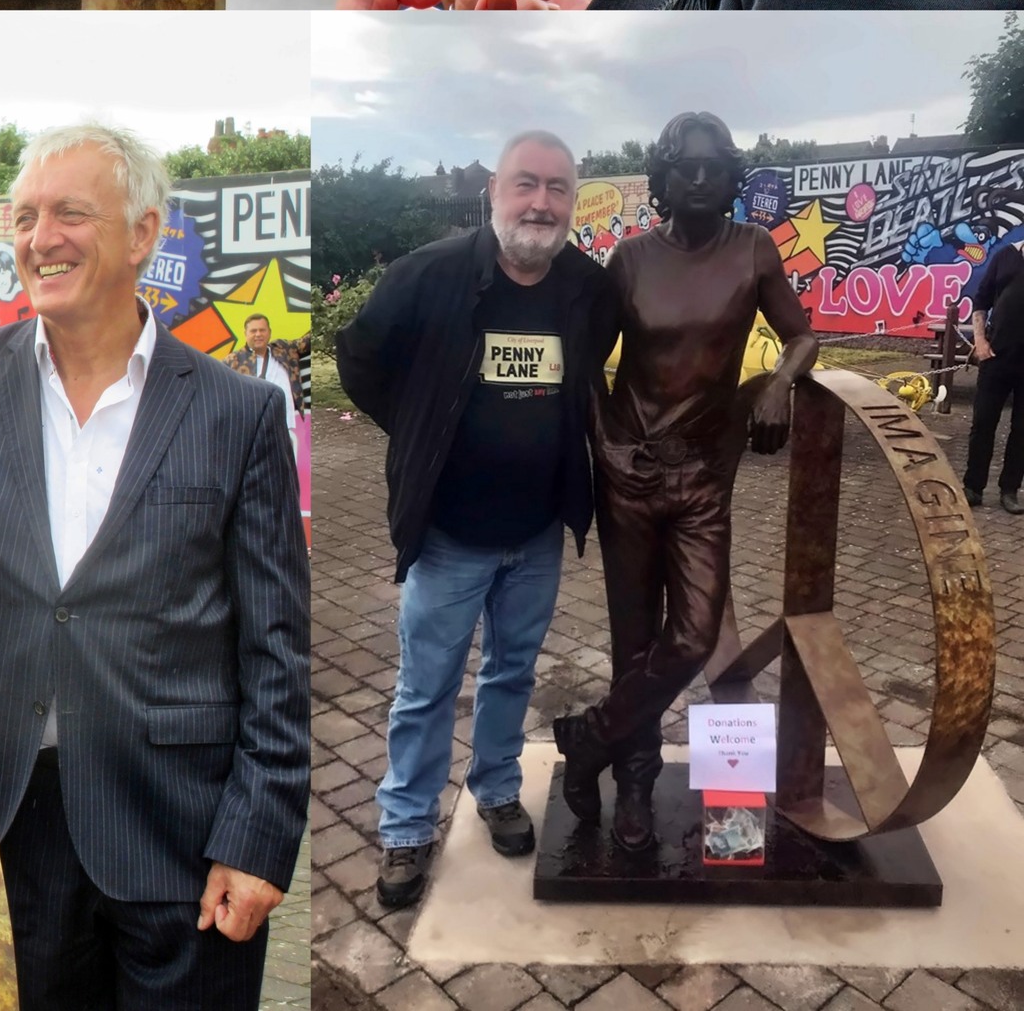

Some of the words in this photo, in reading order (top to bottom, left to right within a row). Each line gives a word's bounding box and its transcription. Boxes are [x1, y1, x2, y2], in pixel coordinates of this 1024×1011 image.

[799, 164, 856, 191] PENNY
[582, 194, 603, 209] PLACE
[605, 189, 615, 201] TO
[752, 195, 779, 211] STEREO
[232, 187, 312, 242] PEN
[819, 261, 973, 322] LOVE
[491, 346, 545, 362] PENNY
[497, 363, 539, 378] LANE
[861, 404, 982, 595] IMAGINE
[708, 718, 757, 727] Donations
[710, 735, 756, 744] Welcome
